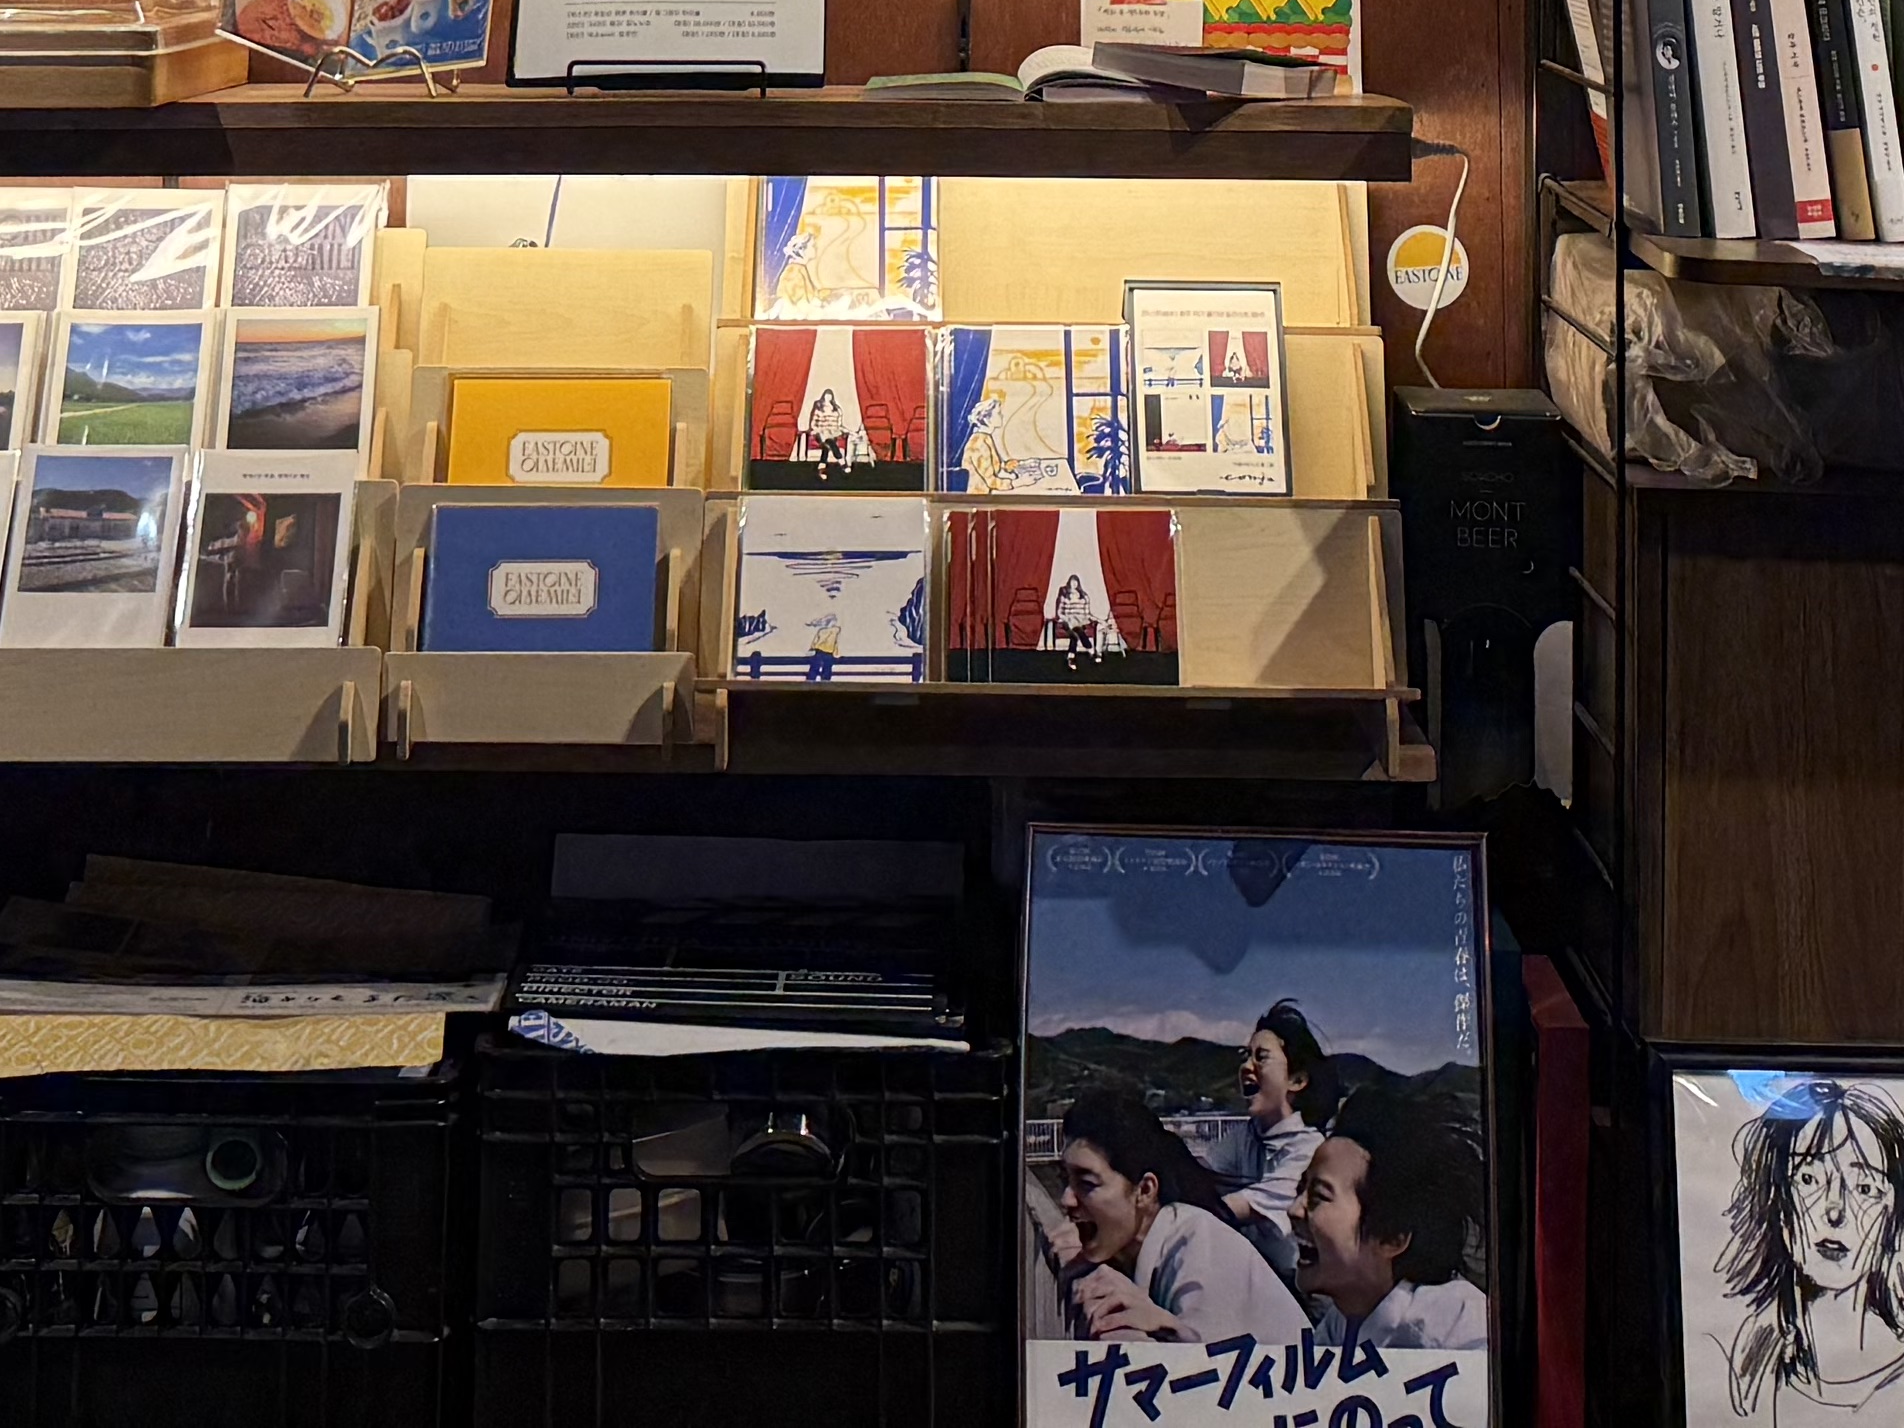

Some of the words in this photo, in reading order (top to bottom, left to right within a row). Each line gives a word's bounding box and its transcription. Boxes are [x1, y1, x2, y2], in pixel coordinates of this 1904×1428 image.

[1395, 268, 1464, 285] EASTCNE
[1448, 499, 1526, 522] MONT
[1456, 527, 1518, 549] BEER
[1057, 1326, 1389, 1428] サマーフィルム
